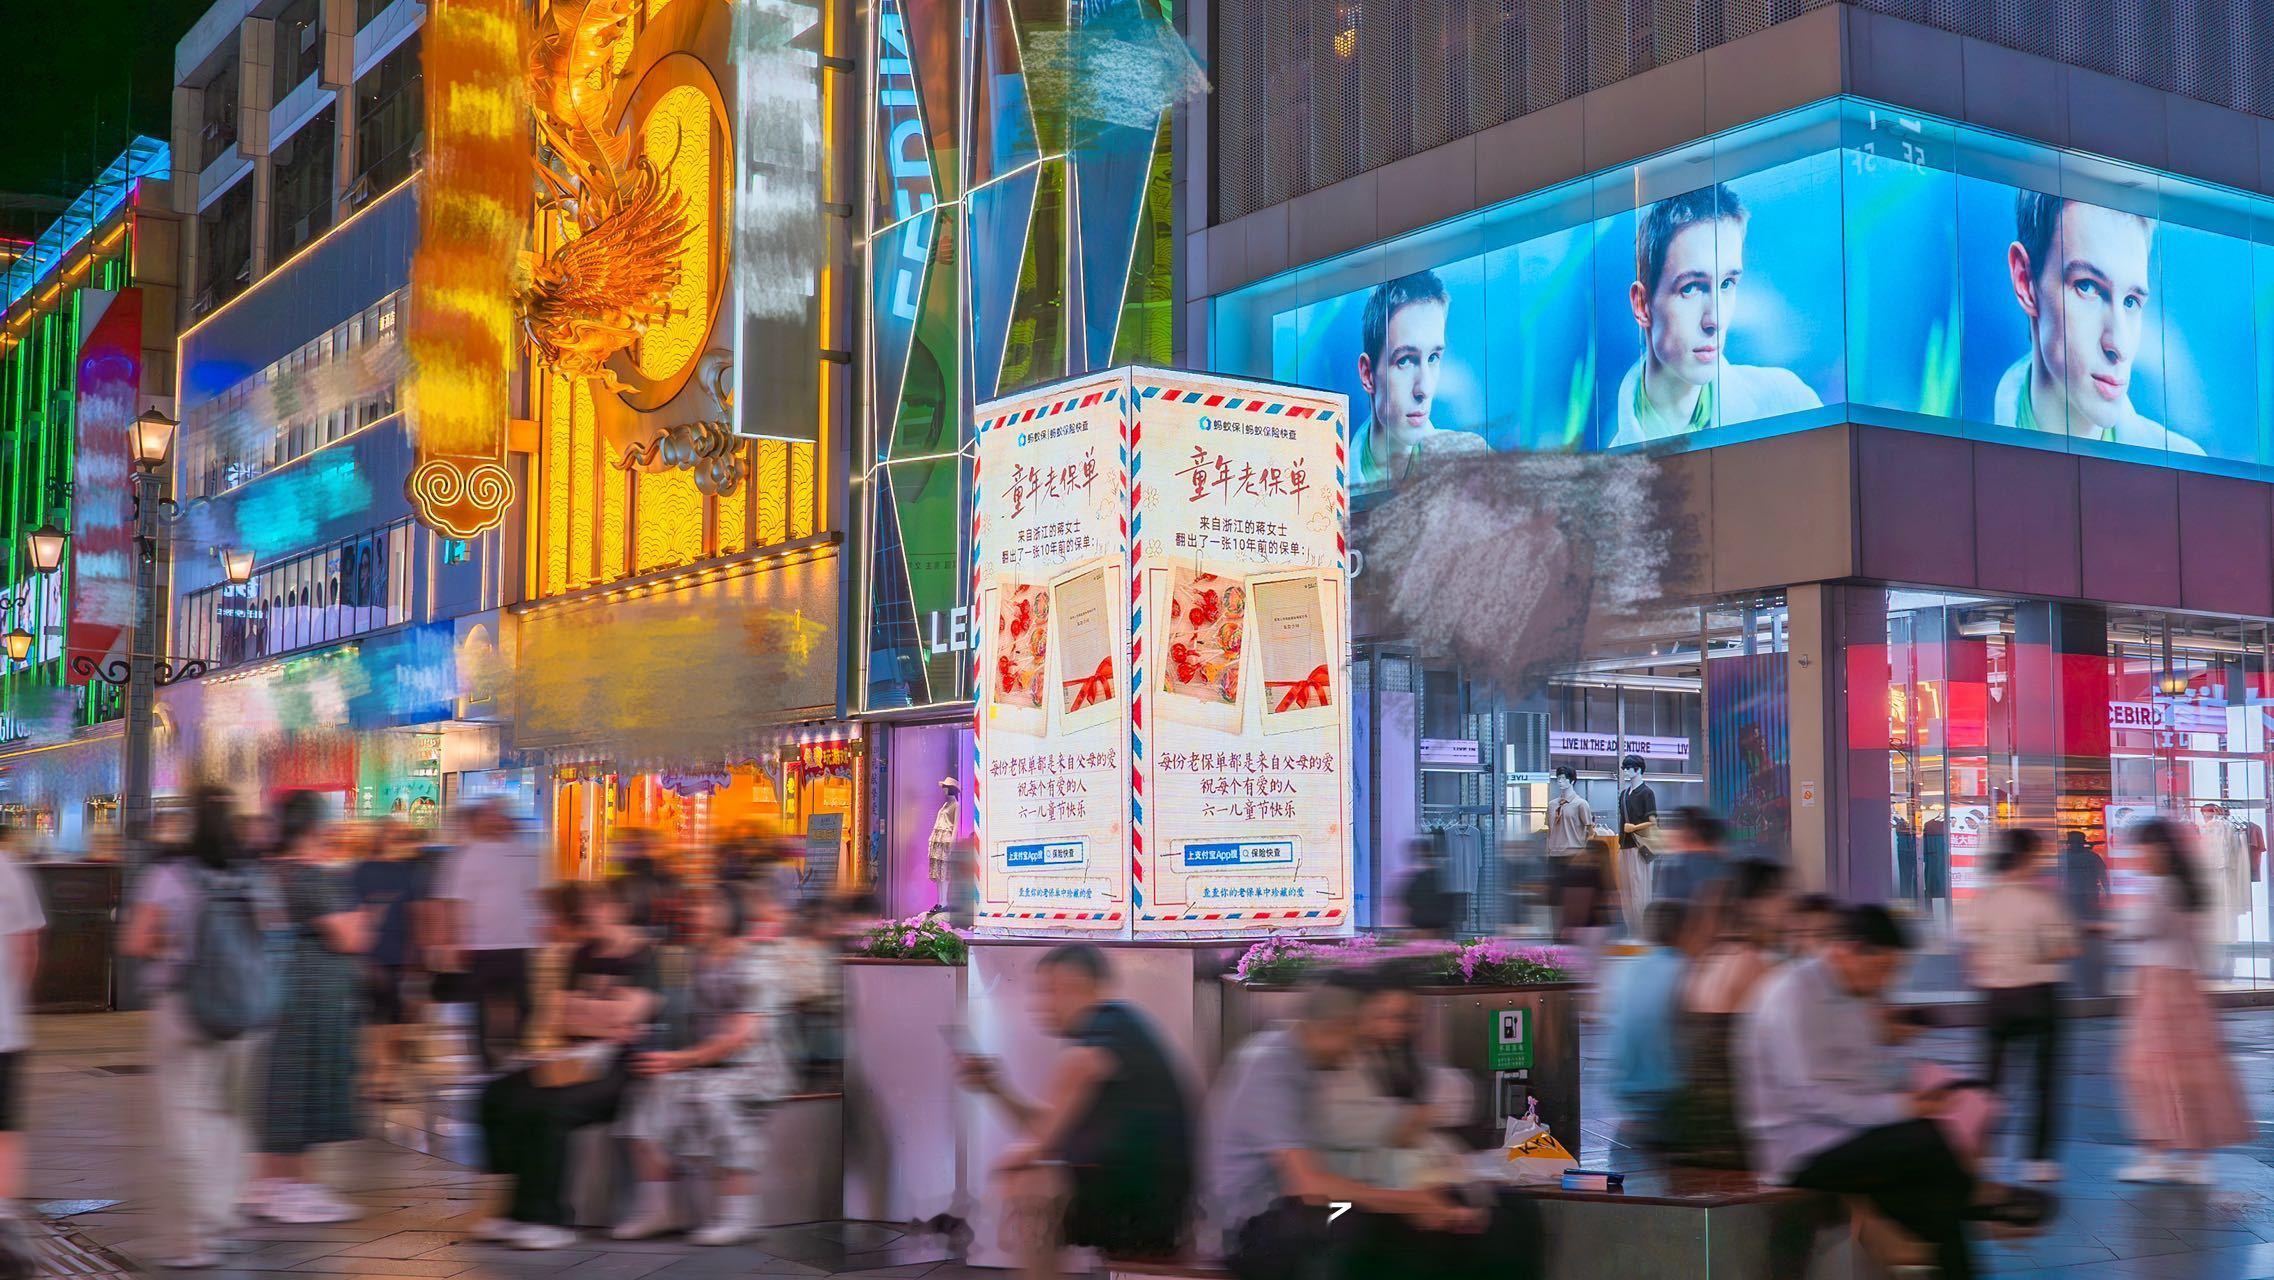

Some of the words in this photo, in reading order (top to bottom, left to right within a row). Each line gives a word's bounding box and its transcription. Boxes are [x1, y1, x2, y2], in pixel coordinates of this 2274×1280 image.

[1002, 446, 1099, 519] 童年老保单
[1175, 445, 1310, 515] 童年老保单
[1018, 519, 1081, 542] 来自浙江的蒋女士
[1200, 516, 1288, 537] 来自浙江的蒋女士
[1562, 738, 1579, 750] LIVE
[1580, 739, 1589, 750] IN
[1590, 739, 1605, 751] THE
[1606, 740, 1651, 753] ADENTURE
[990, 748, 1117, 777] 每份老保单都是来自父母的爱
[1159, 751, 1335, 774] 每份老保单都是来自父母的爱
[1018, 776, 1087, 797] 祝每个有爱的人
[1200, 775, 1297, 796] 祝每个有爱的人
[1018, 800, 1087, 822] 六一儿童节快乐
[1202, 800, 1296, 821] 六一儿童节快乐
